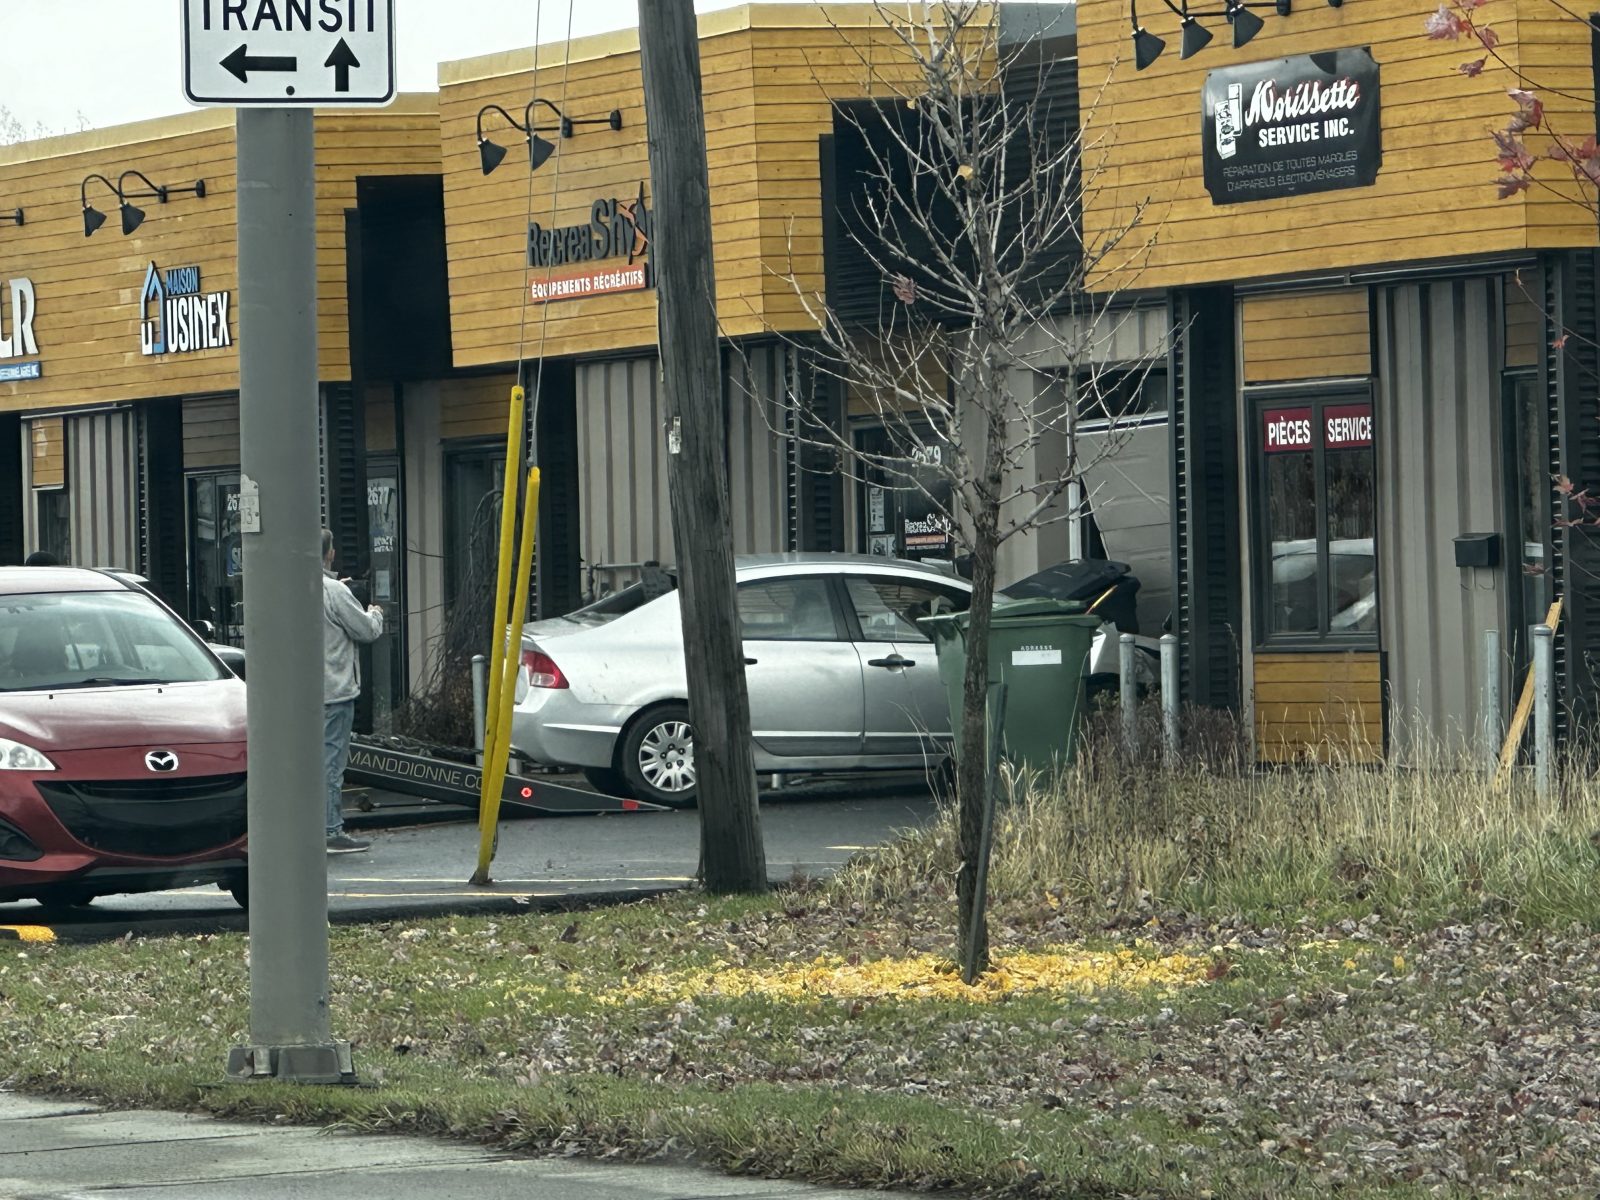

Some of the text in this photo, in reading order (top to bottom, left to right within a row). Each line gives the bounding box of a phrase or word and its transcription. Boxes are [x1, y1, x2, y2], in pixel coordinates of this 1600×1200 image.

[203, 0, 375, 33] TRANSIT
[1244, 77, 1360, 127] Morissette
[1258, 117, 1355, 148] SERVICE INC.
[1272, 160, 1284, 172] DE
[1286, 155, 1317, 171] TOUTES
[1318, 149, 1358, 165] MARQUES
[165, 267, 200, 295] MAISON
[531, 269, 644, 299] ÉQUIPEMENTS RÉCRÉATIFS
[166, 291, 231, 353] USINEX
[1268, 415, 1311, 446] PIÈCES
[367, 486, 389, 506] 2677
